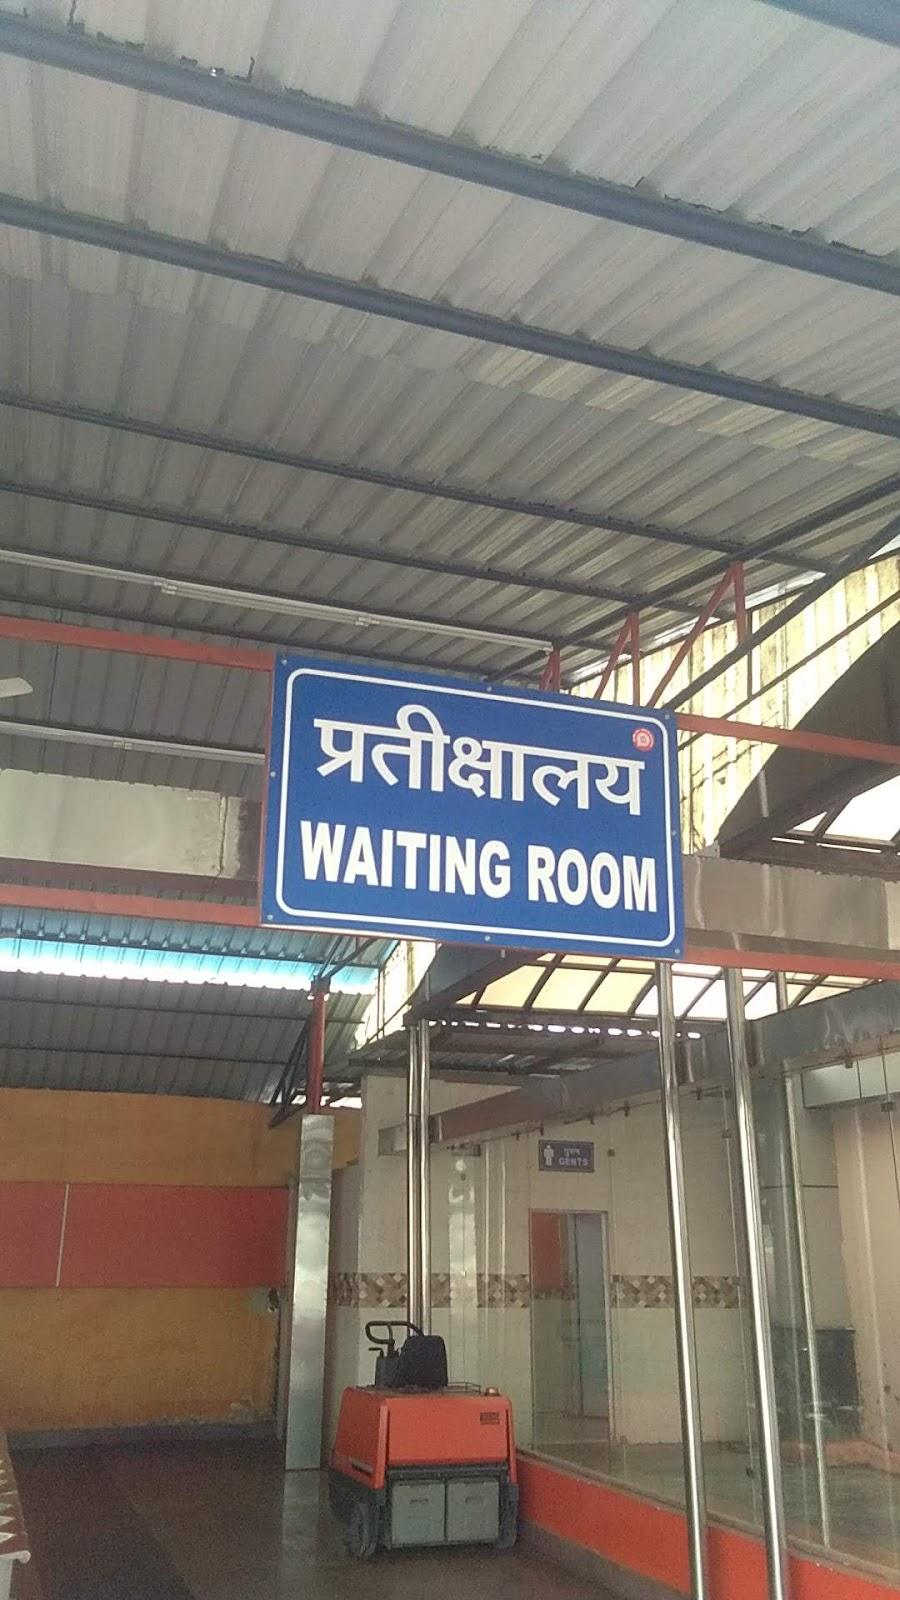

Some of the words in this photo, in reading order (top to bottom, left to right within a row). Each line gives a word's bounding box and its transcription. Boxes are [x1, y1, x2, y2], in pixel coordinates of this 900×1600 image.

[313, 704, 645, 816] प्रतीक्षालय
[300, 820, 511, 899] WAITING
[528, 844, 657, 913] ROOM
[558, 1157, 589, 1166] GENTS
